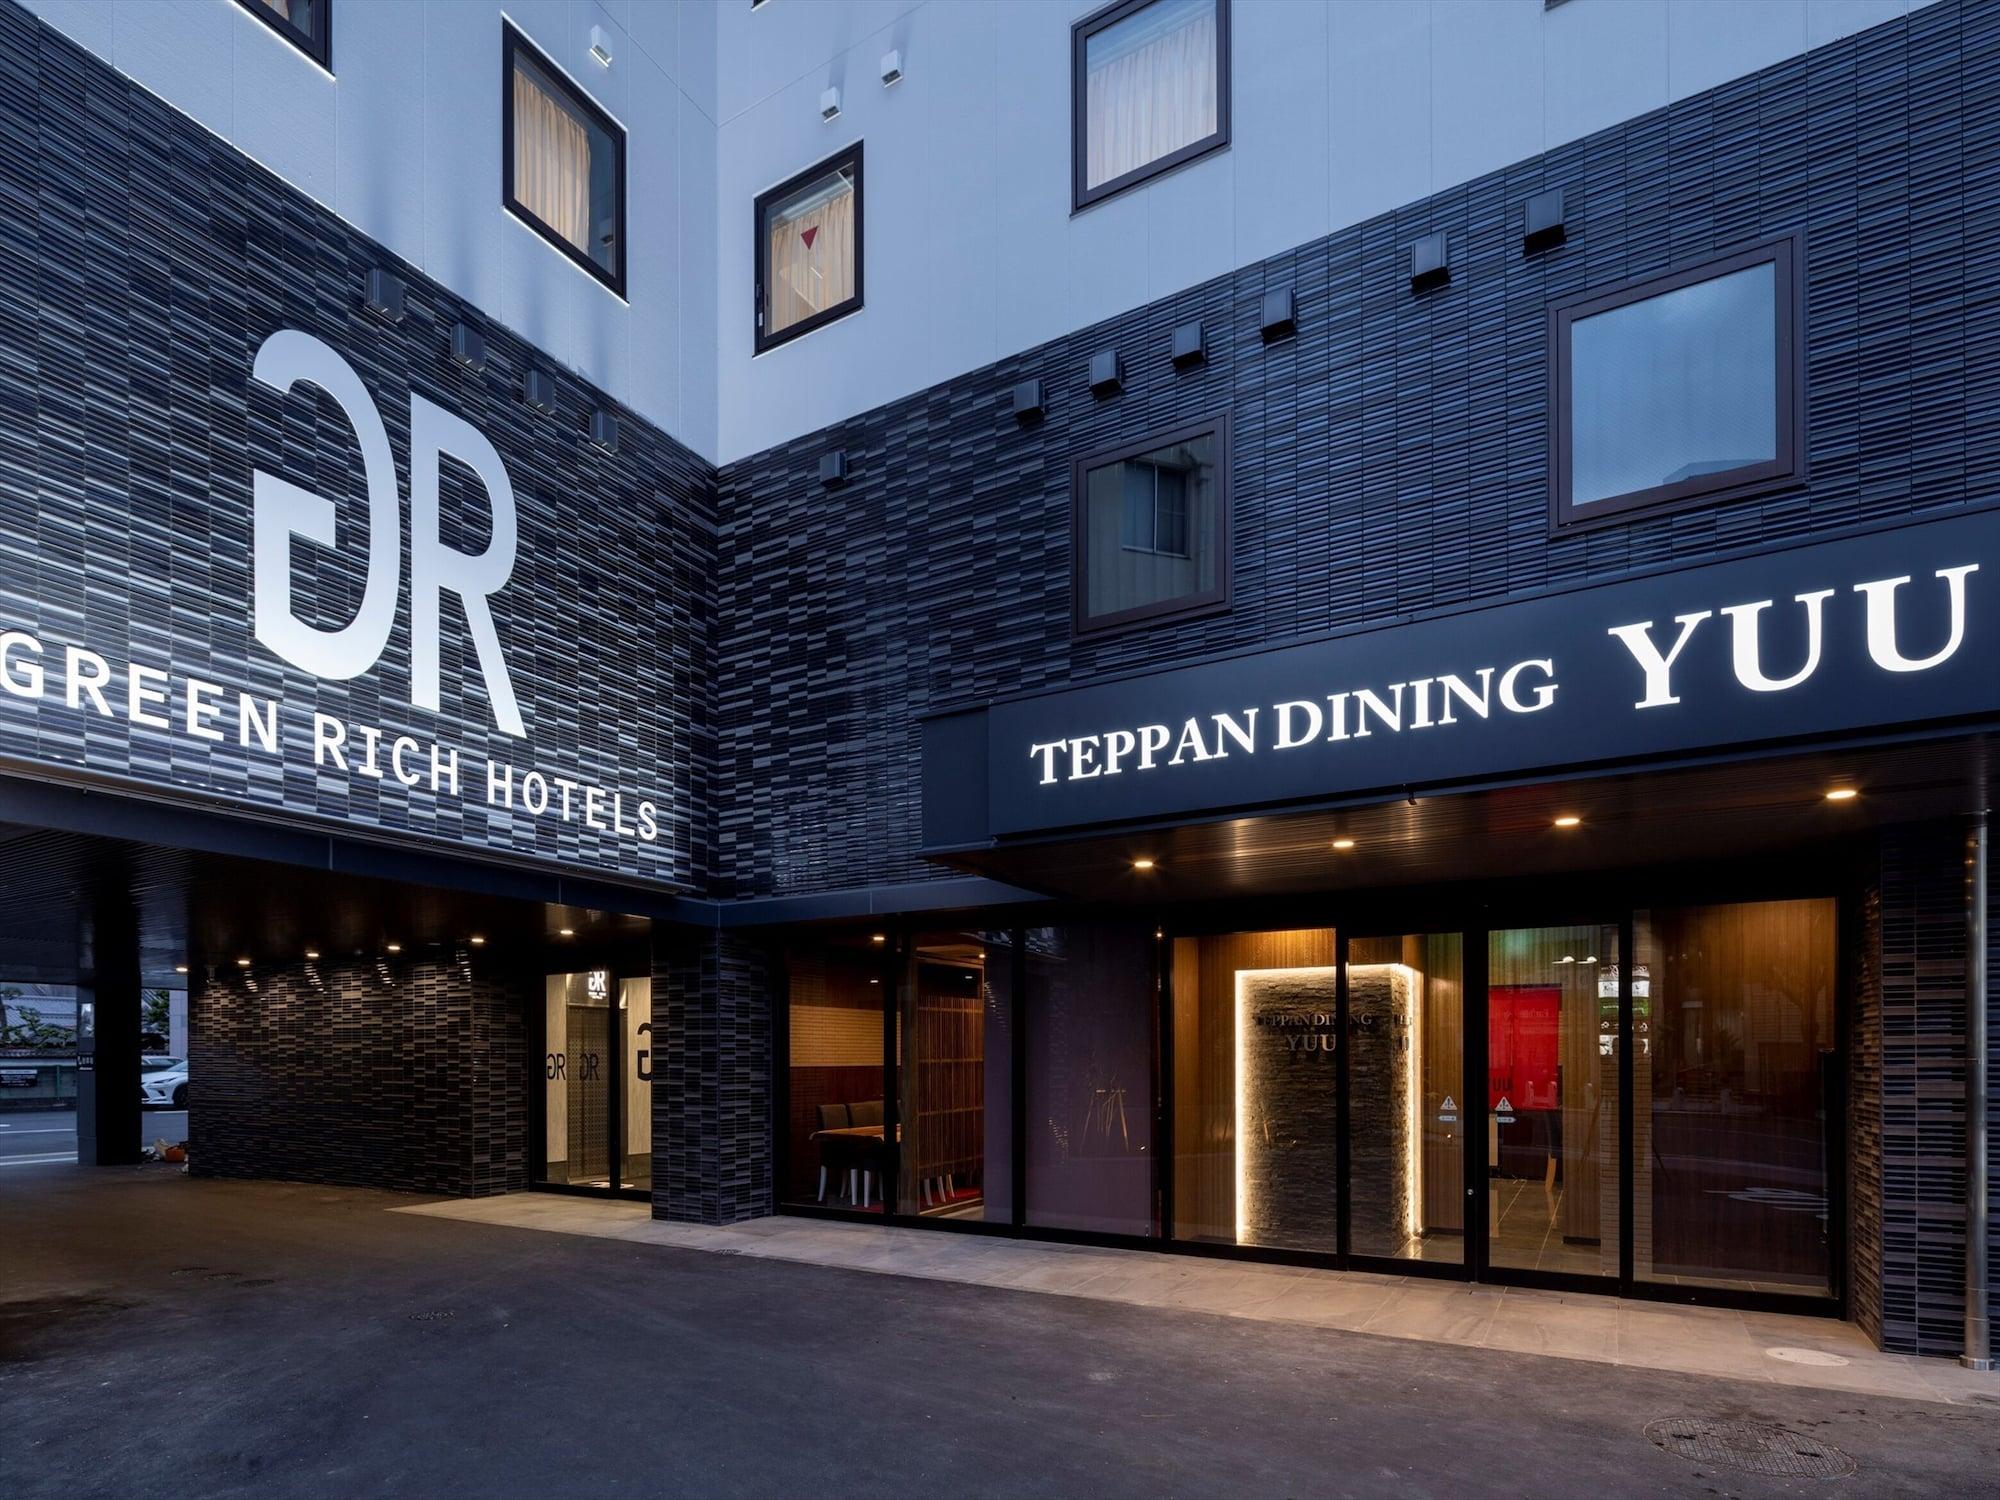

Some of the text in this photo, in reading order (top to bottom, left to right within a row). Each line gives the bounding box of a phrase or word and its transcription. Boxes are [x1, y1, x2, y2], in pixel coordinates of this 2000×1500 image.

[1030, 563, 1981, 786] TEPPAN DINING YUU
[0, 631, 658, 842] GREEN RICH HOTELS
[1287, 1033, 1337, 1051] YUU
[1314, 1013, 1373, 1026] DING
